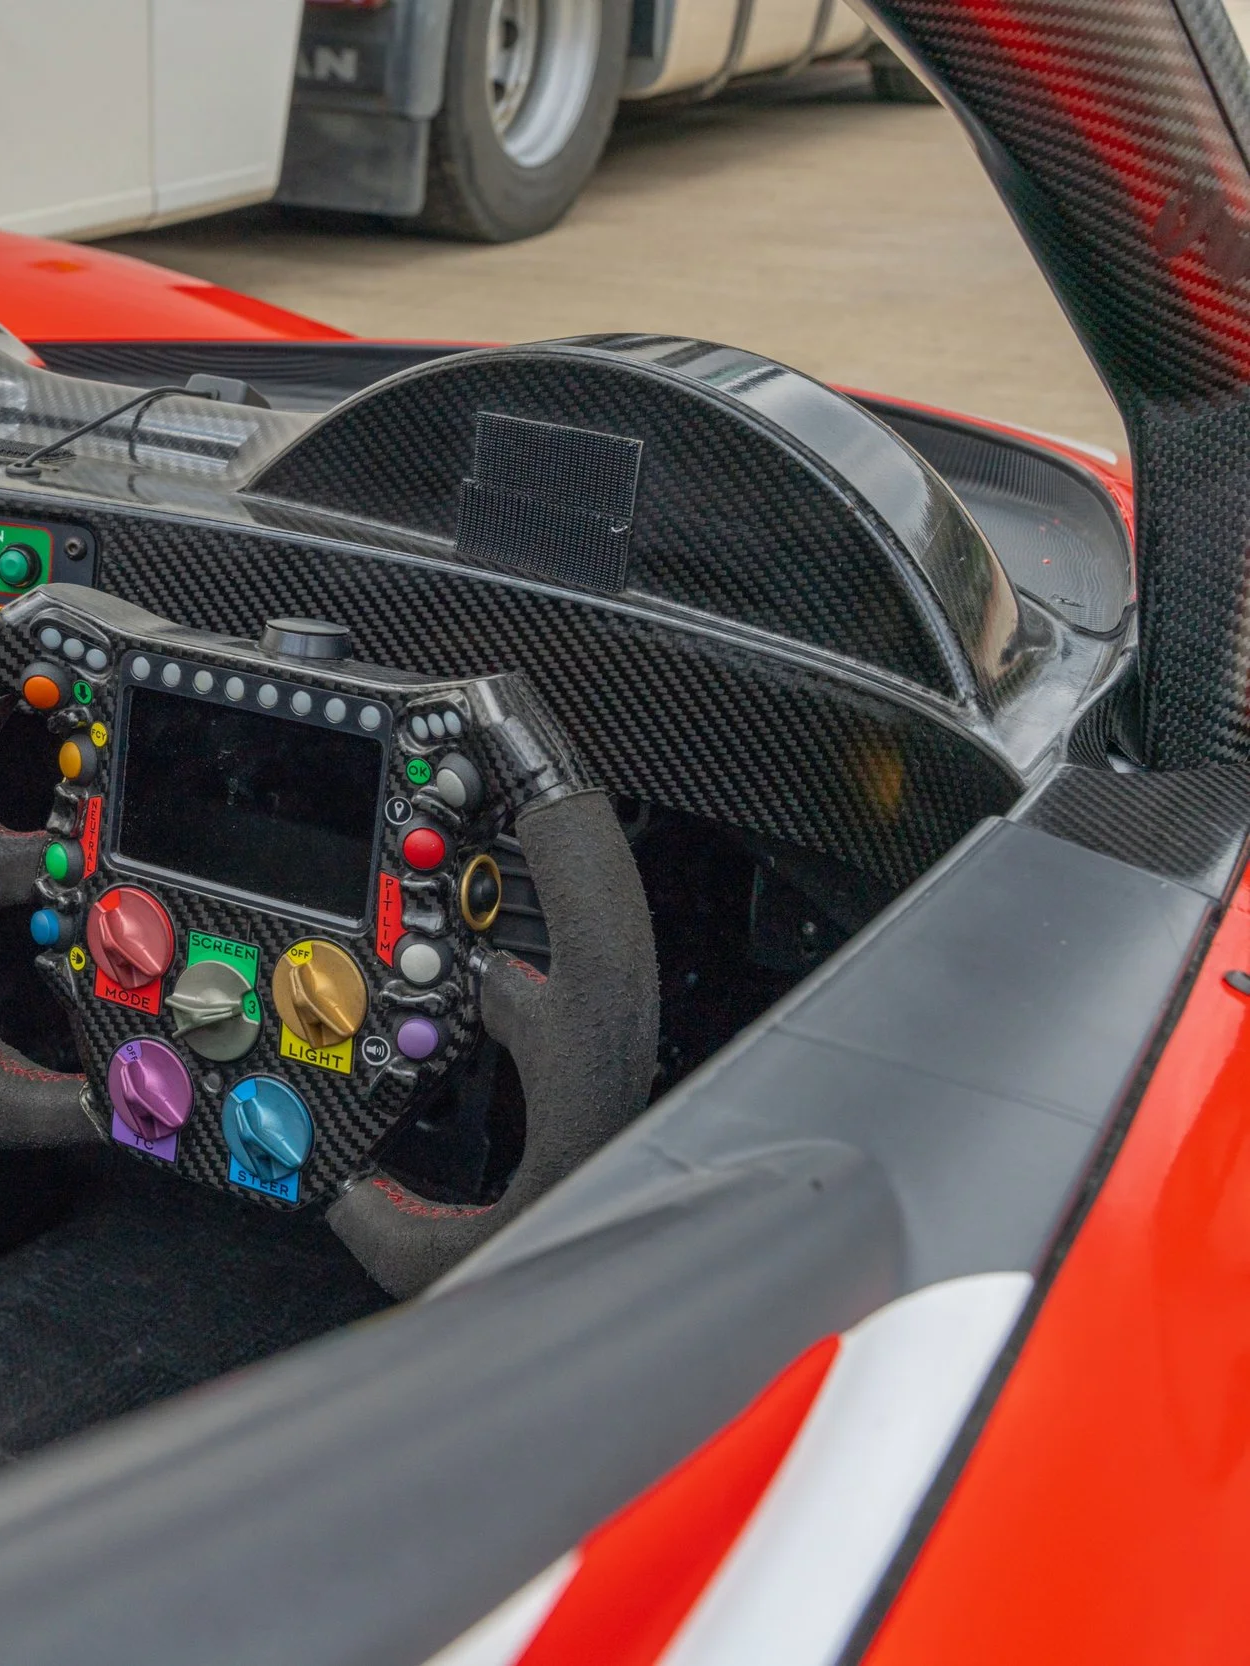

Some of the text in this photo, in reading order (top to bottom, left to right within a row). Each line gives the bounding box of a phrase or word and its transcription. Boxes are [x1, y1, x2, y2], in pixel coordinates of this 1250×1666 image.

[91, 728, 107, 741] FCY
[408, 765, 428, 778] OK
[86, 801, 99, 872] NEUTRAL
[190, 934, 256, 961] SCREEN
[290, 948, 310, 959] OFF
[105, 985, 151, 1010] MODE
[248, 1000, 257, 1014] 3
[126, 1044, 138, 1061] OFF
[288, 1042, 344, 1069] LIGHT
[133, 1134, 154, 1150] TC
[237, 1170, 289, 1197] STEER
